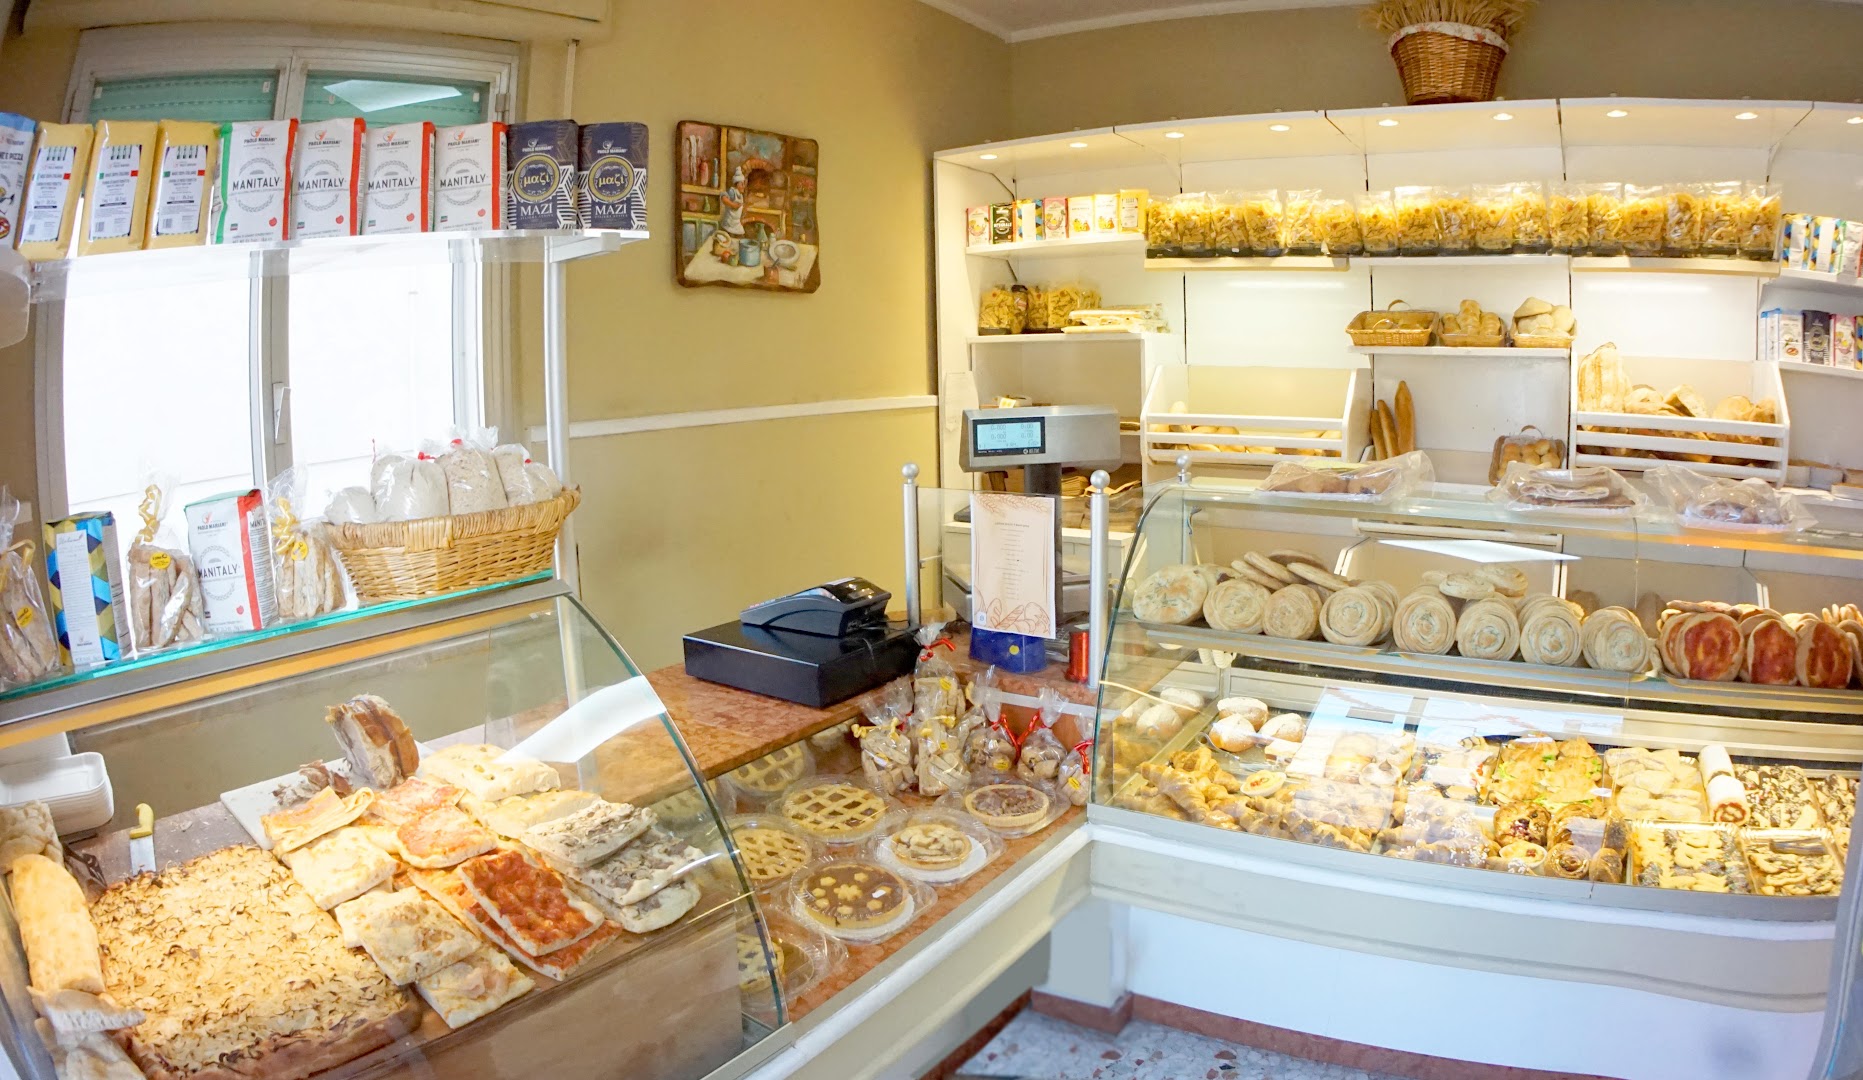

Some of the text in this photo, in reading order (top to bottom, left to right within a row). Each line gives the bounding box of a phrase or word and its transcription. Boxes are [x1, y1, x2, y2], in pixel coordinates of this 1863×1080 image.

[232, 176, 280, 191] MANITALY
[297, 177, 345, 191] MANITALY
[368, 176, 415, 191] MANITALY
[440, 173, 486, 188] MANITALY
[520, 203, 553, 217] MAZI
[595, 203, 627, 216] MAZI
[198, 564, 238, 579] MANITALY
